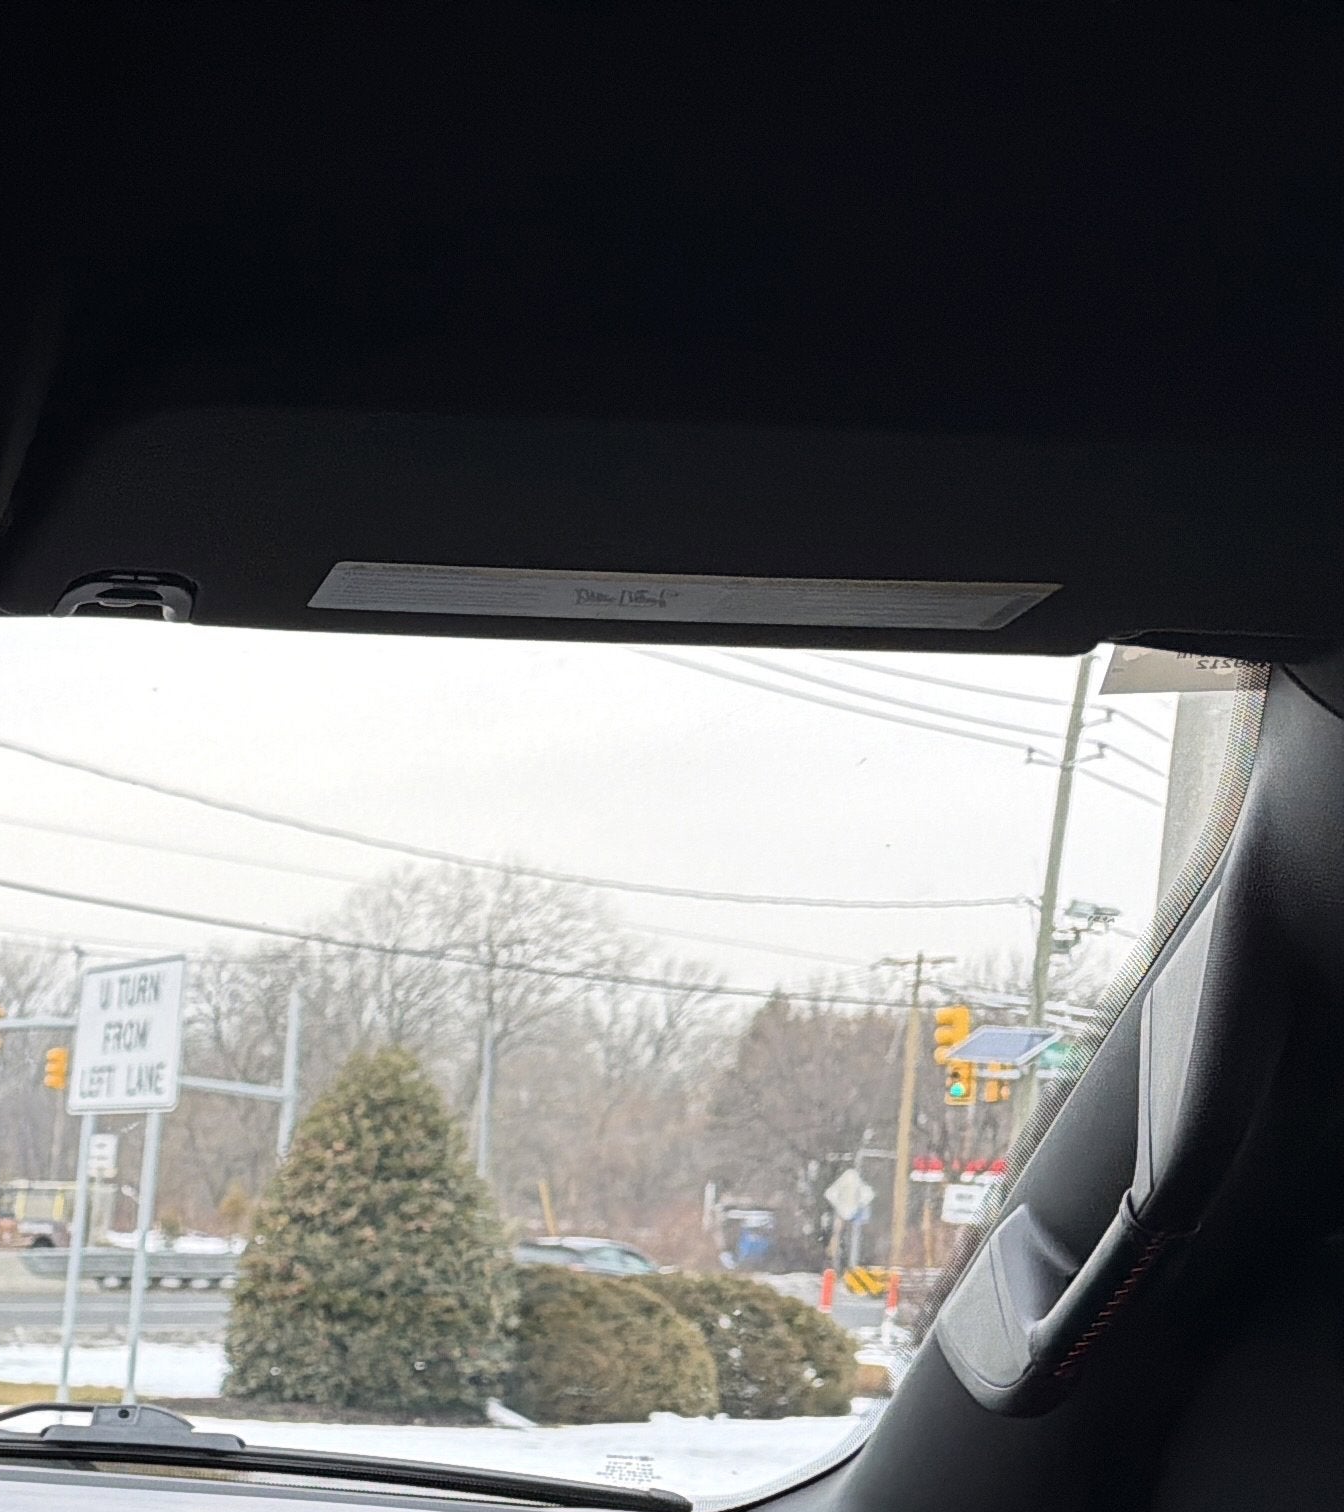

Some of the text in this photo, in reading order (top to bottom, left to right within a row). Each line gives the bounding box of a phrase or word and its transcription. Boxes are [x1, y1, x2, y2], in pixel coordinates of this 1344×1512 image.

[99, 971, 162, 1011] U TURN
[101, 1018, 152, 1055] FROM
[79, 1062, 168, 1099] LEFT LANE
